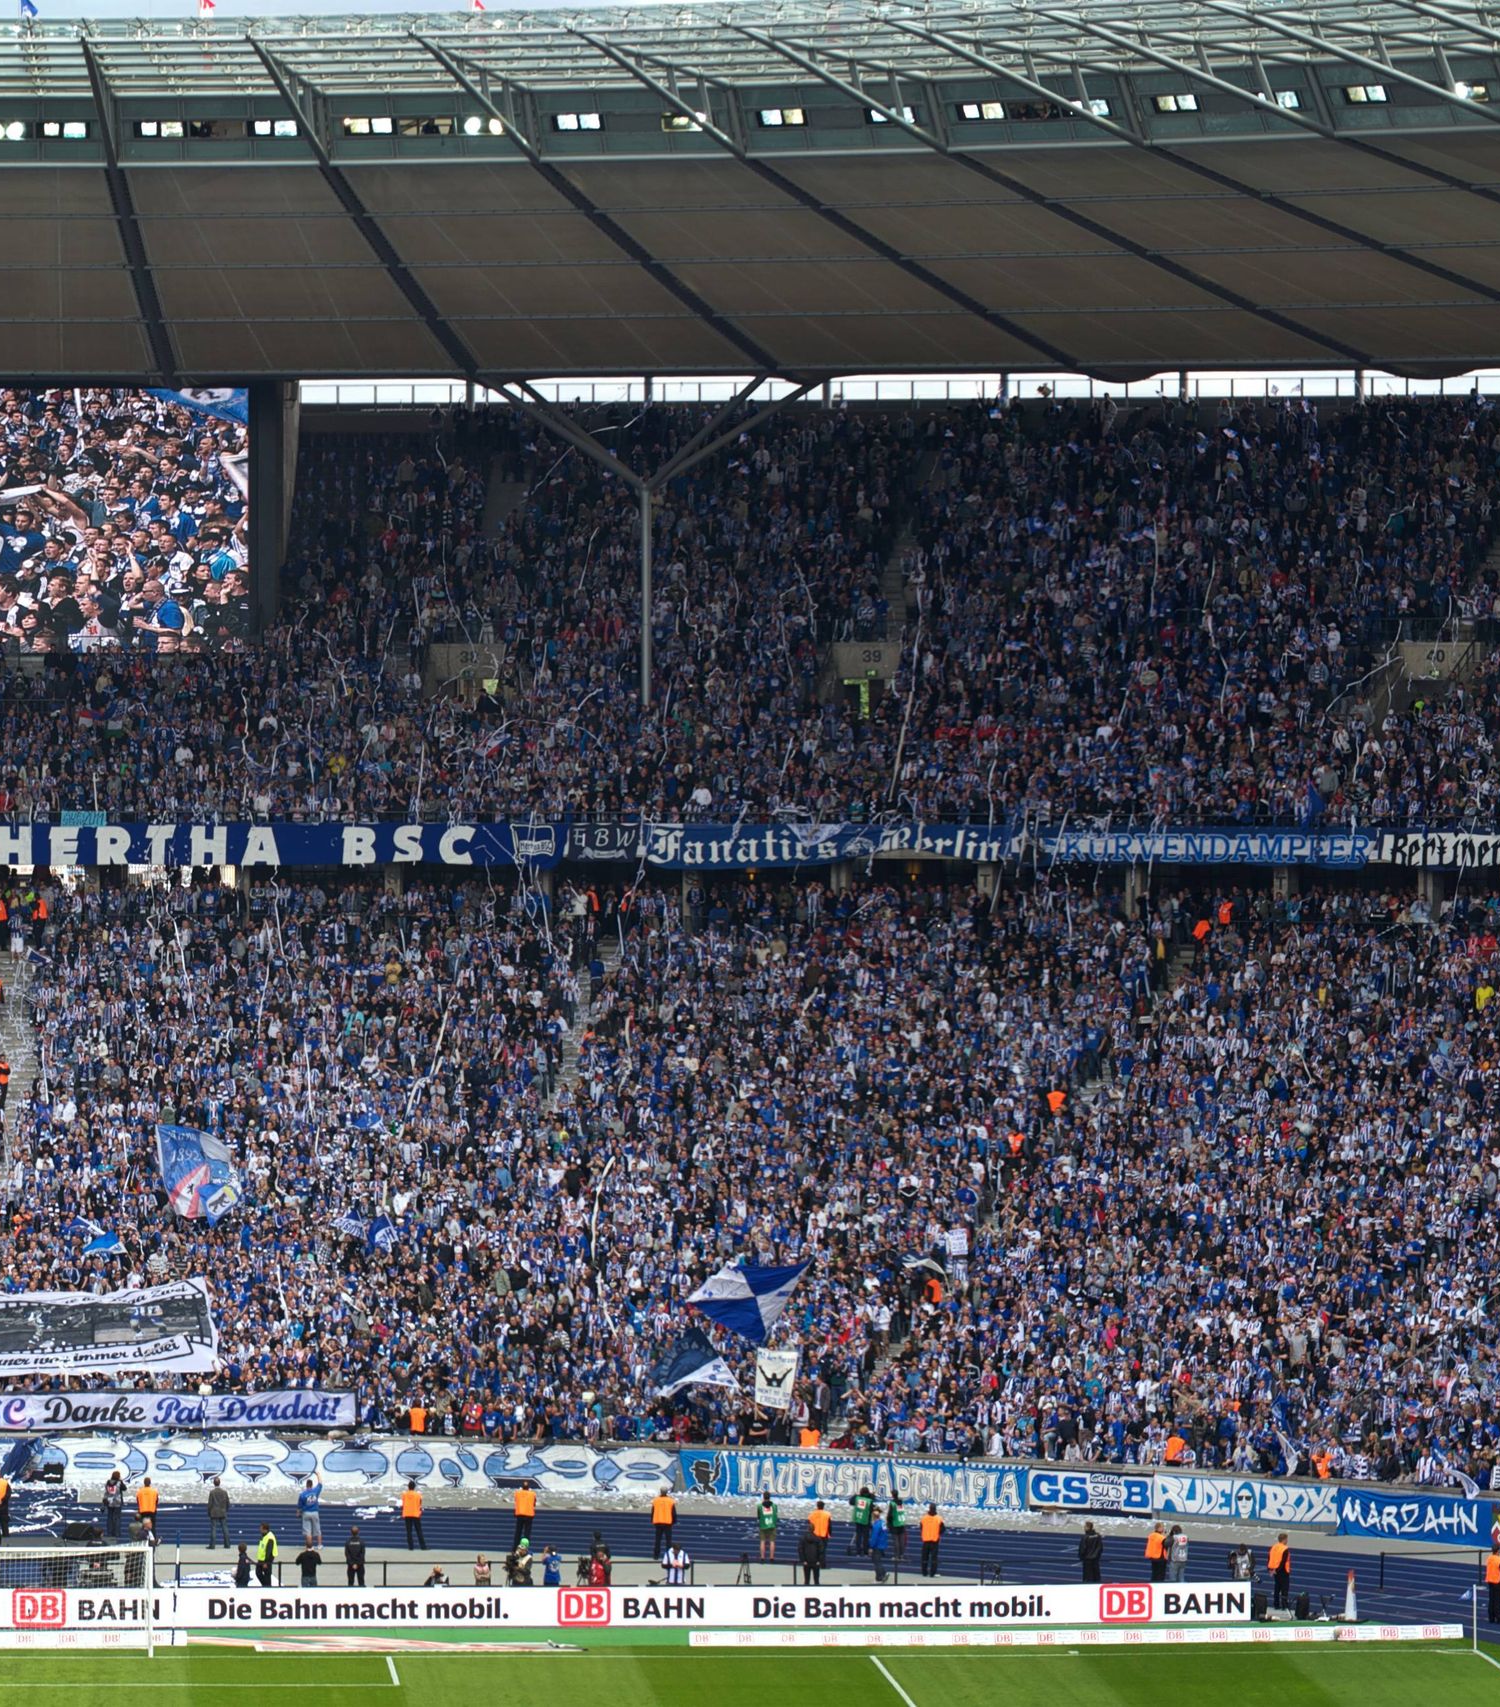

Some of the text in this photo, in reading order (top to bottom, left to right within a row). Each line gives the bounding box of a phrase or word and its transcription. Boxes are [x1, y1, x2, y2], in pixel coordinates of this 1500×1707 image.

[863, 650, 881, 663] 39
[1426, 649, 1445, 662] 40
[342, 824, 477, 865] BSC
[73, 1350, 126, 1364] immer
[43, 1396, 147, 1424] Danke
[212, 1393, 341, 1422] Dardai!
[1153, 1477, 1338, 1522] RUDE BOYS
[1342, 1497, 1478, 1534] MARZAHN
[19, 1595, 160, 1621] DB BAHN
[208, 1597, 253, 1620] Die
[260, 1597, 327, 1620] Bahn
[335, 1597, 419, 1620] macht
[563, 1594, 705, 1619] DB BAHN
[753, 1596, 796, 1618] Die
[804, 1596, 871, 1618] Bahn
[879, 1596, 962, 1618] macht
[1106, 1590, 1245, 1615] DB BAHN
